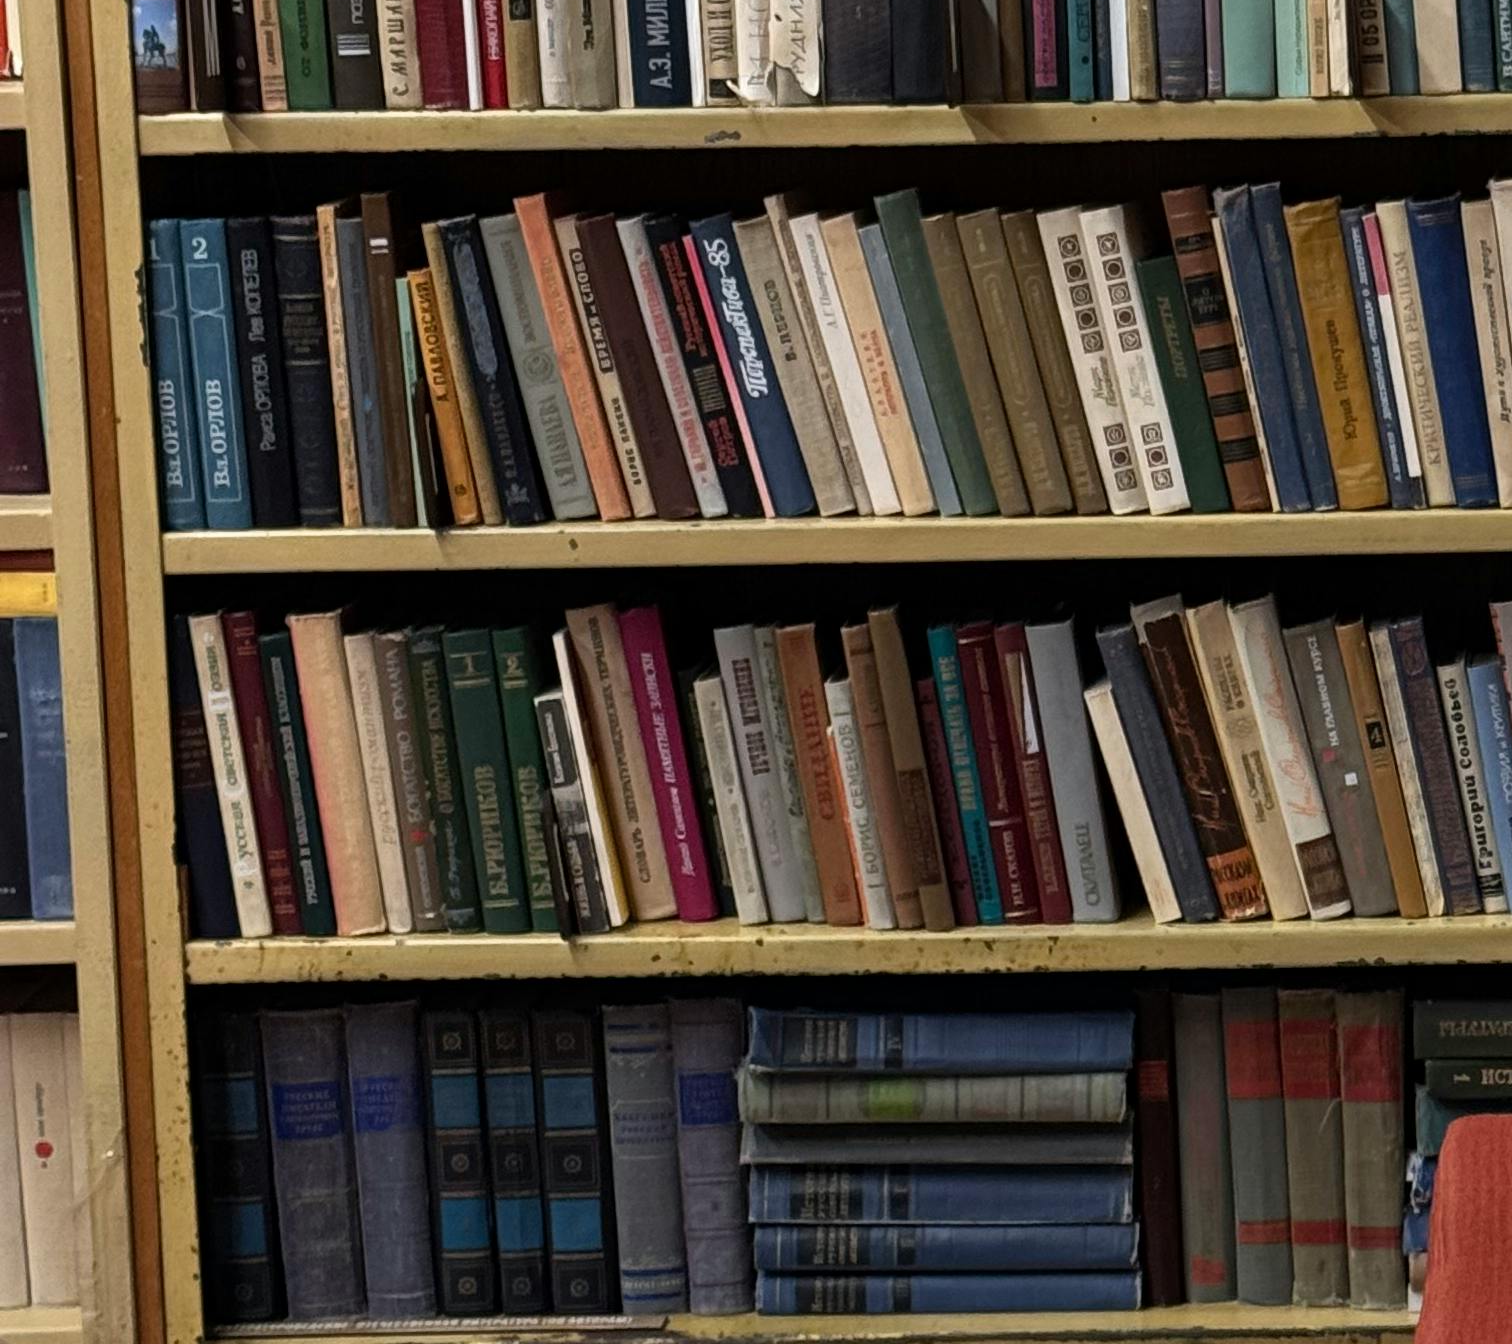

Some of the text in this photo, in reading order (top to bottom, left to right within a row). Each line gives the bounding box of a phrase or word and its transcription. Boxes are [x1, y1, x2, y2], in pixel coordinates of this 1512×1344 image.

[707, 26, 735, 63] УХОД
[1362, 23, 1378, 46] ОБ
[649, 52, 673, 89] А.Э.
[191, 236, 208, 260] 2
[571, 251, 594, 303] СЛОВО
[414, 280, 445, 386] ПАВЛОВСКИЙ
[590, 316, 612, 368] ВРЕМЯ
[1392, 250, 1442, 466] КРИТИЧЕСКИЙ РЕАЛИЗМ
[384, 648, 409, 721] РОМАНА
[838, 723, 881, 875] БОРИС СЕМЕНОВ
[1444, 677, 1492, 869] Григорий Соловьев
